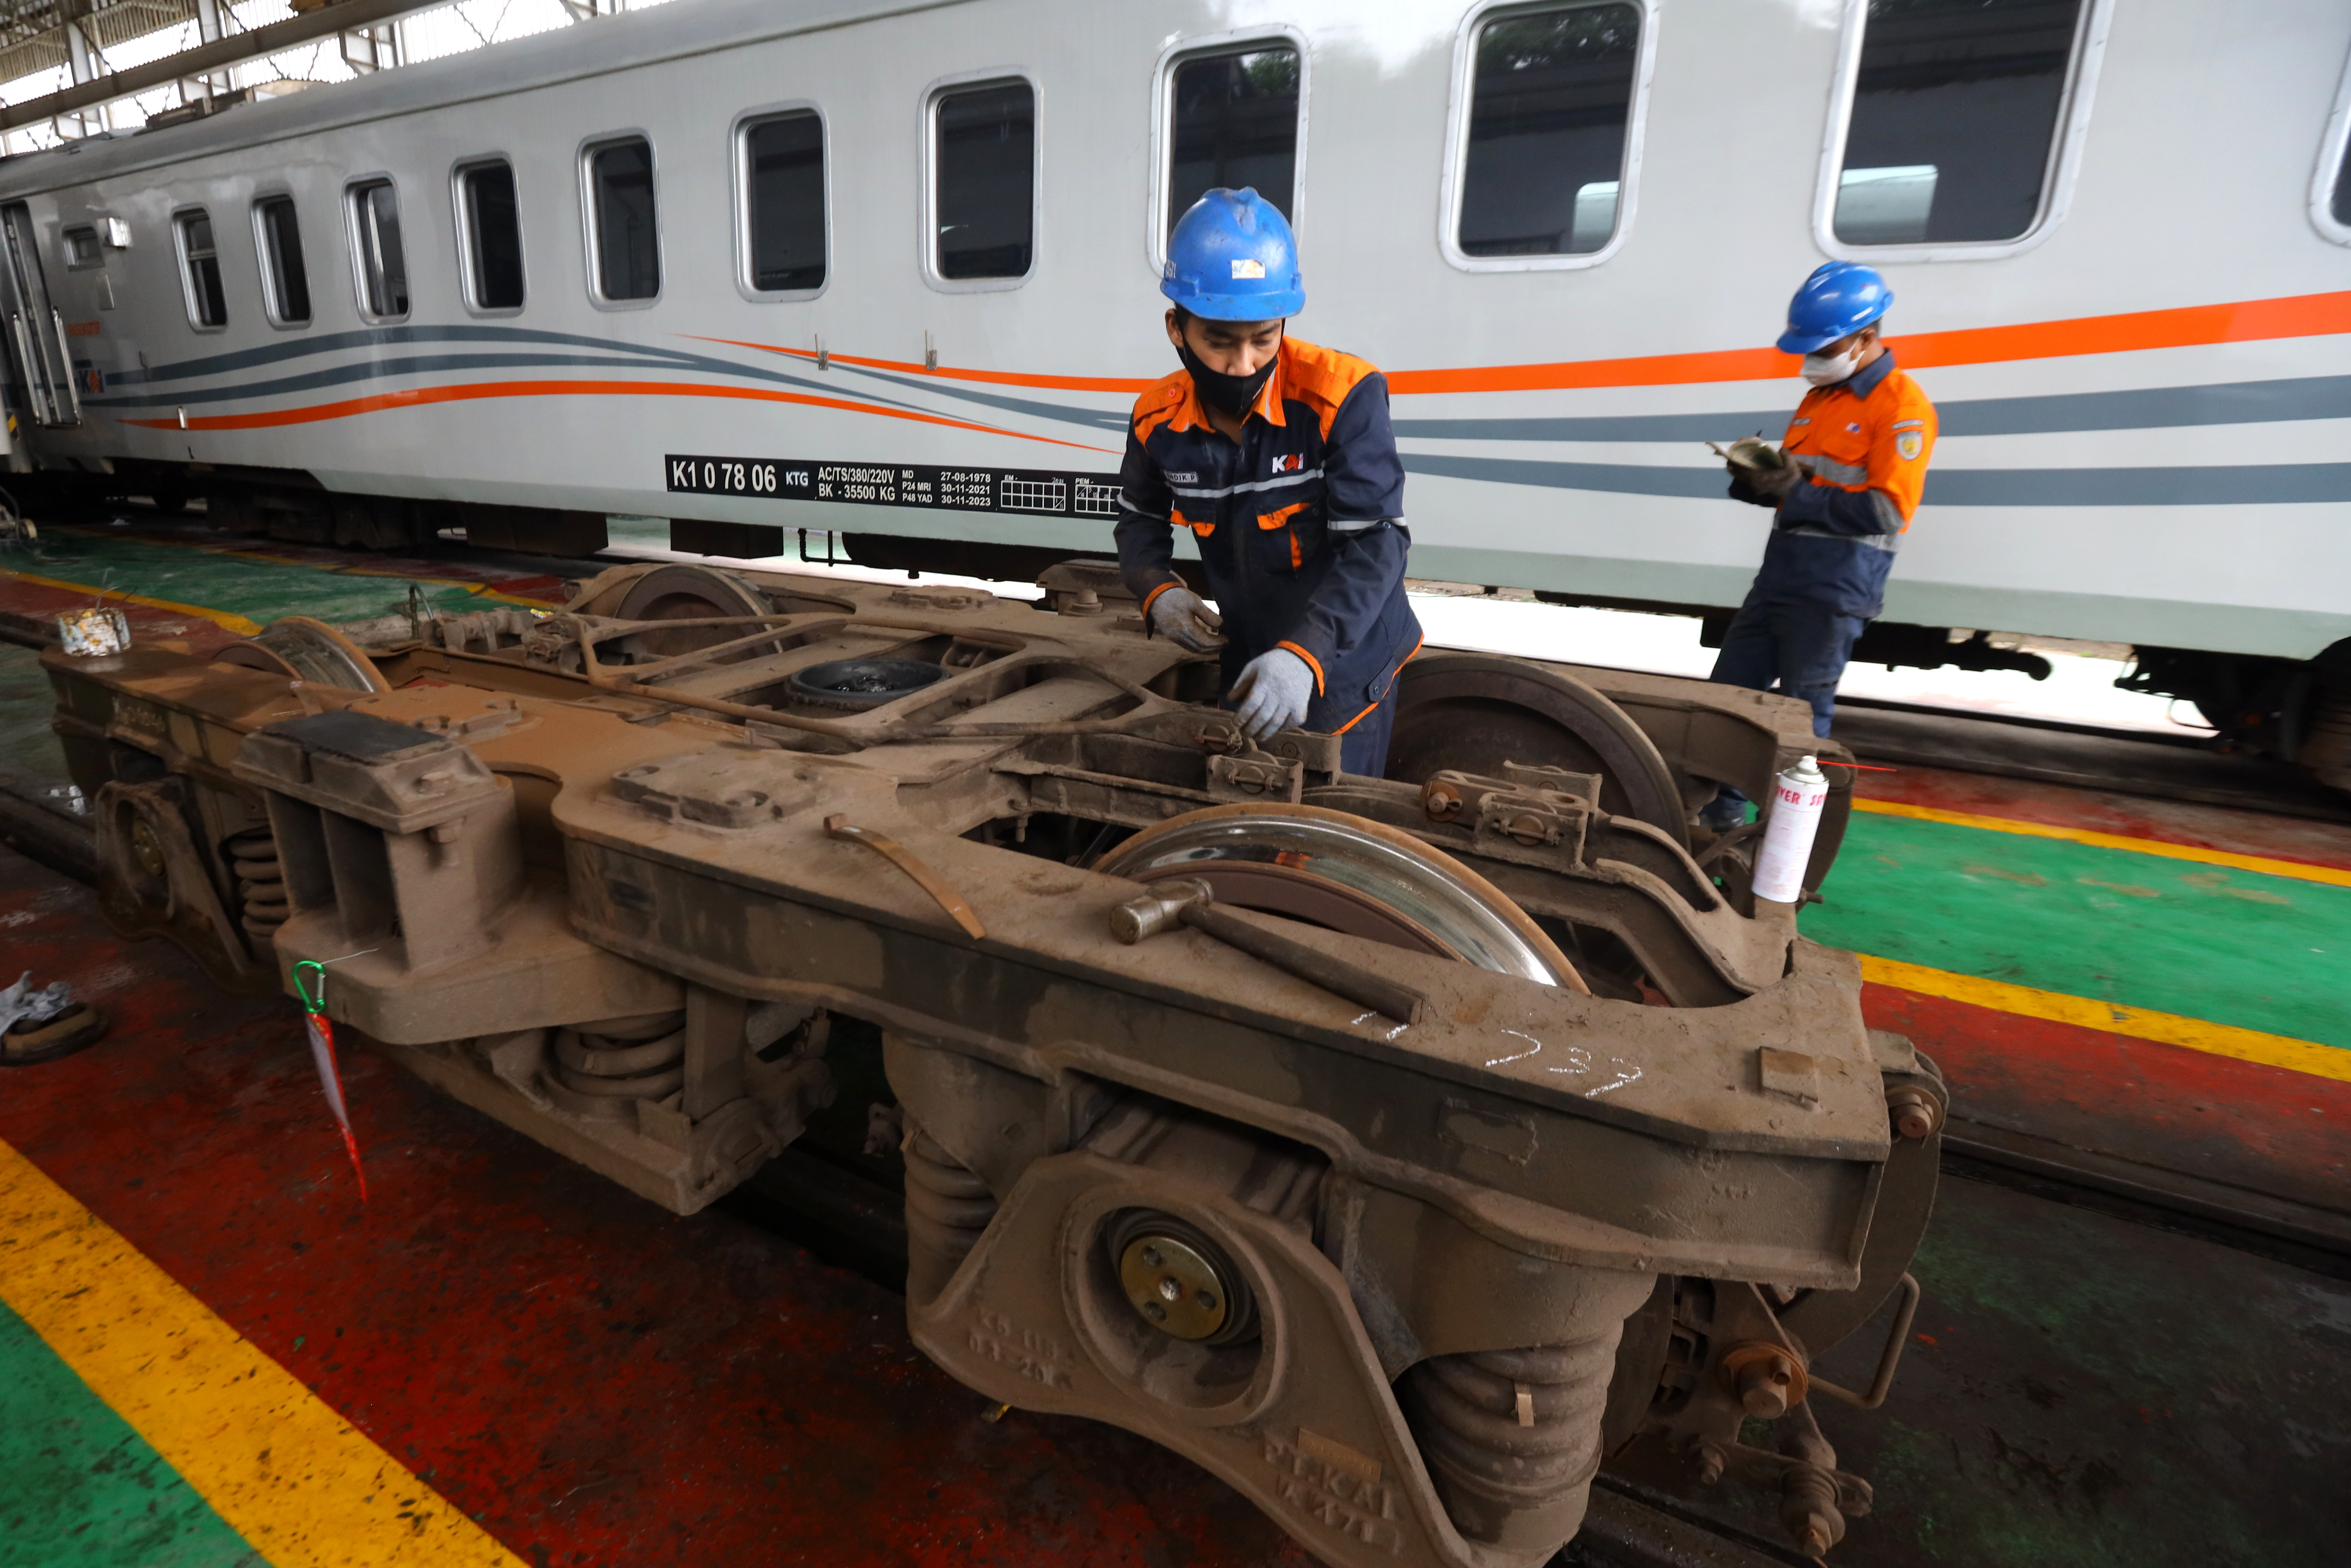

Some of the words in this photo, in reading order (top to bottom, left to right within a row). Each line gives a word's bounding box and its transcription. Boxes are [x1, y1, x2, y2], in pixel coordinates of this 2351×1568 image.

[1272, 453, 1304, 473] KAI
[785, 471, 809, 487] KTG
[818, 466, 895, 484] AC/TS/380/220V
[902, 469, 914, 479] MD
[940, 471, 992, 483] 27-08-1978
[818, 483, 833, 498] BK
[880, 485, 896, 501] KG
[902, 481, 916, 491] P24
[917, 482, 932, 492] MRI
[941, 483, 990, 495] 30-11-2021
[902, 492, 916, 502] P48
[917, 493, 933, 504] YAD
[941, 495, 992, 507] 30-11-2023
